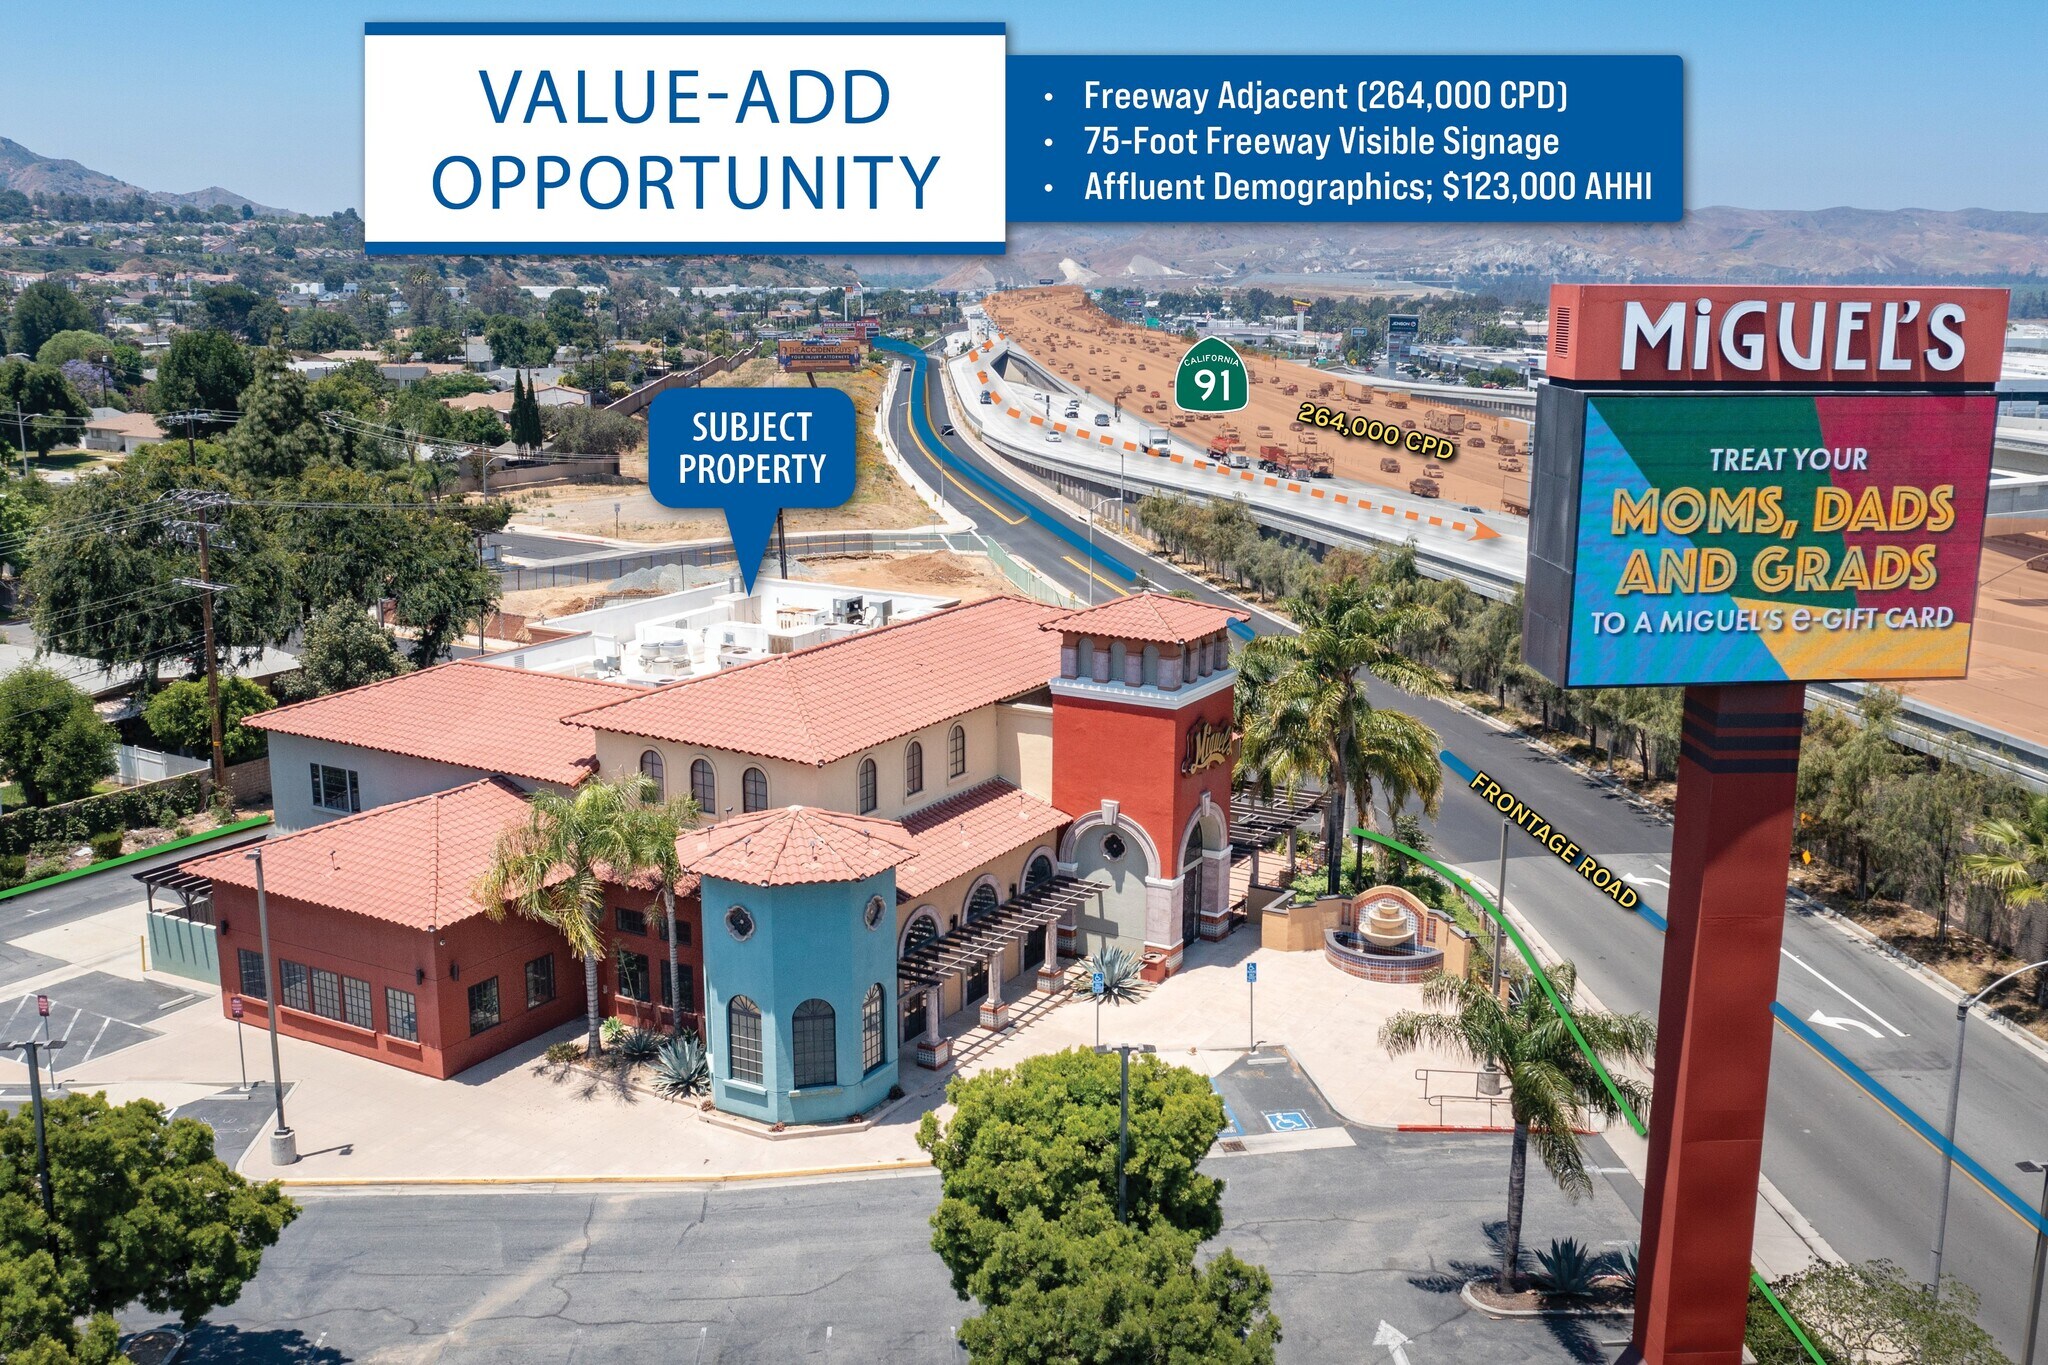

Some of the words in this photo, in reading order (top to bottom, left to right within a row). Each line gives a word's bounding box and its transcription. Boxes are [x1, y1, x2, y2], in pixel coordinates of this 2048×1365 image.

[1710, 448, 1787, 471] TREAT
[1792, 447, 1868, 471] YOUR
[1611, 486, 1799, 540] MOMS,
[1812, 484, 1956, 533] DADS
[1615, 547, 1738, 595] AND
[1752, 544, 1938, 593] GRADS
[1591, 611, 1626, 635] TO
[1633, 611, 1653, 634] A
[1659, 608, 1784, 633] MIGUEL'S
[1791, 607, 1879, 632] e-GIFT
[1884, 606, 1954, 629] CARD
